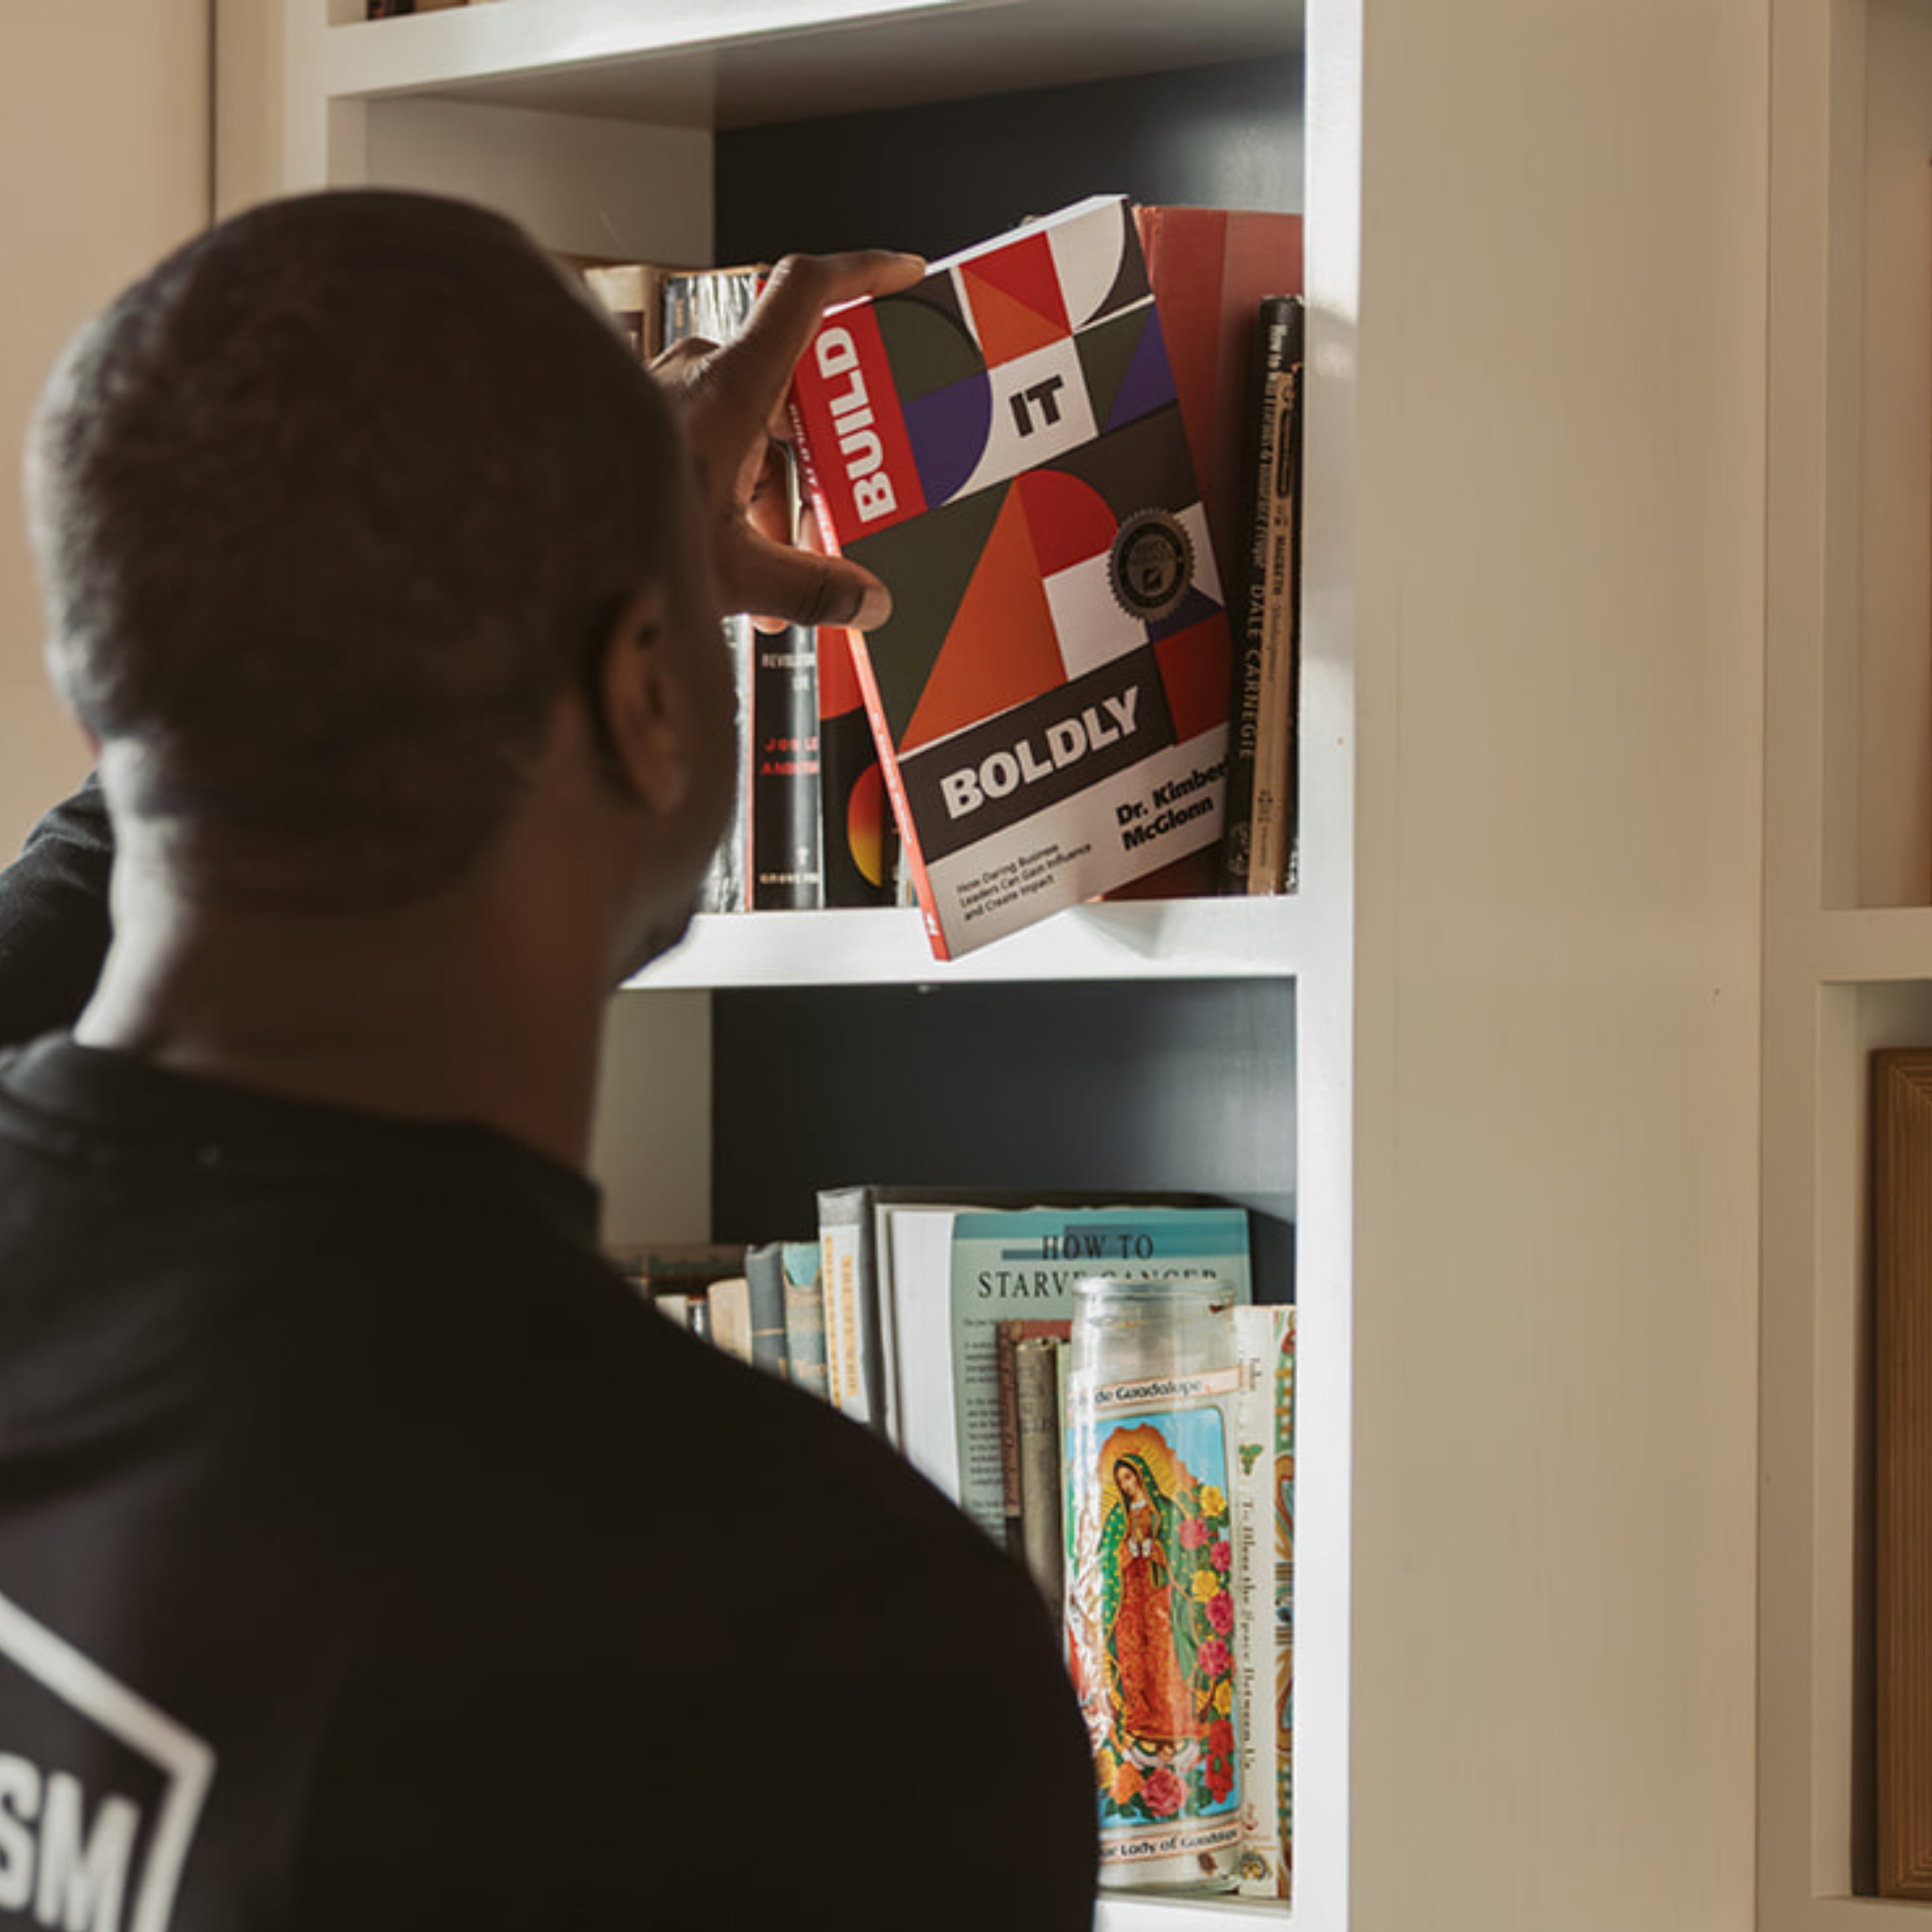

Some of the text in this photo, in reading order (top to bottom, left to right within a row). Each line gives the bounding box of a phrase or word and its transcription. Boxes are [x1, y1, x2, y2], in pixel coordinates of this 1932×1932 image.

[814, 326, 897, 523] BUILD
[1008, 375, 1064, 438] IT
[1246, 584, 1264, 638] DALE
[1240, 650, 1261, 758] CARNEGIE
[940, 686, 1139, 819] BOLDLY
[1116, 802, 1148, 825] Dr.
[1122, 796, 1214, 851] McGlonn
[1042, 1234, 1154, 1260] HOW TO
[978, 1270, 1087, 1298] STARV
